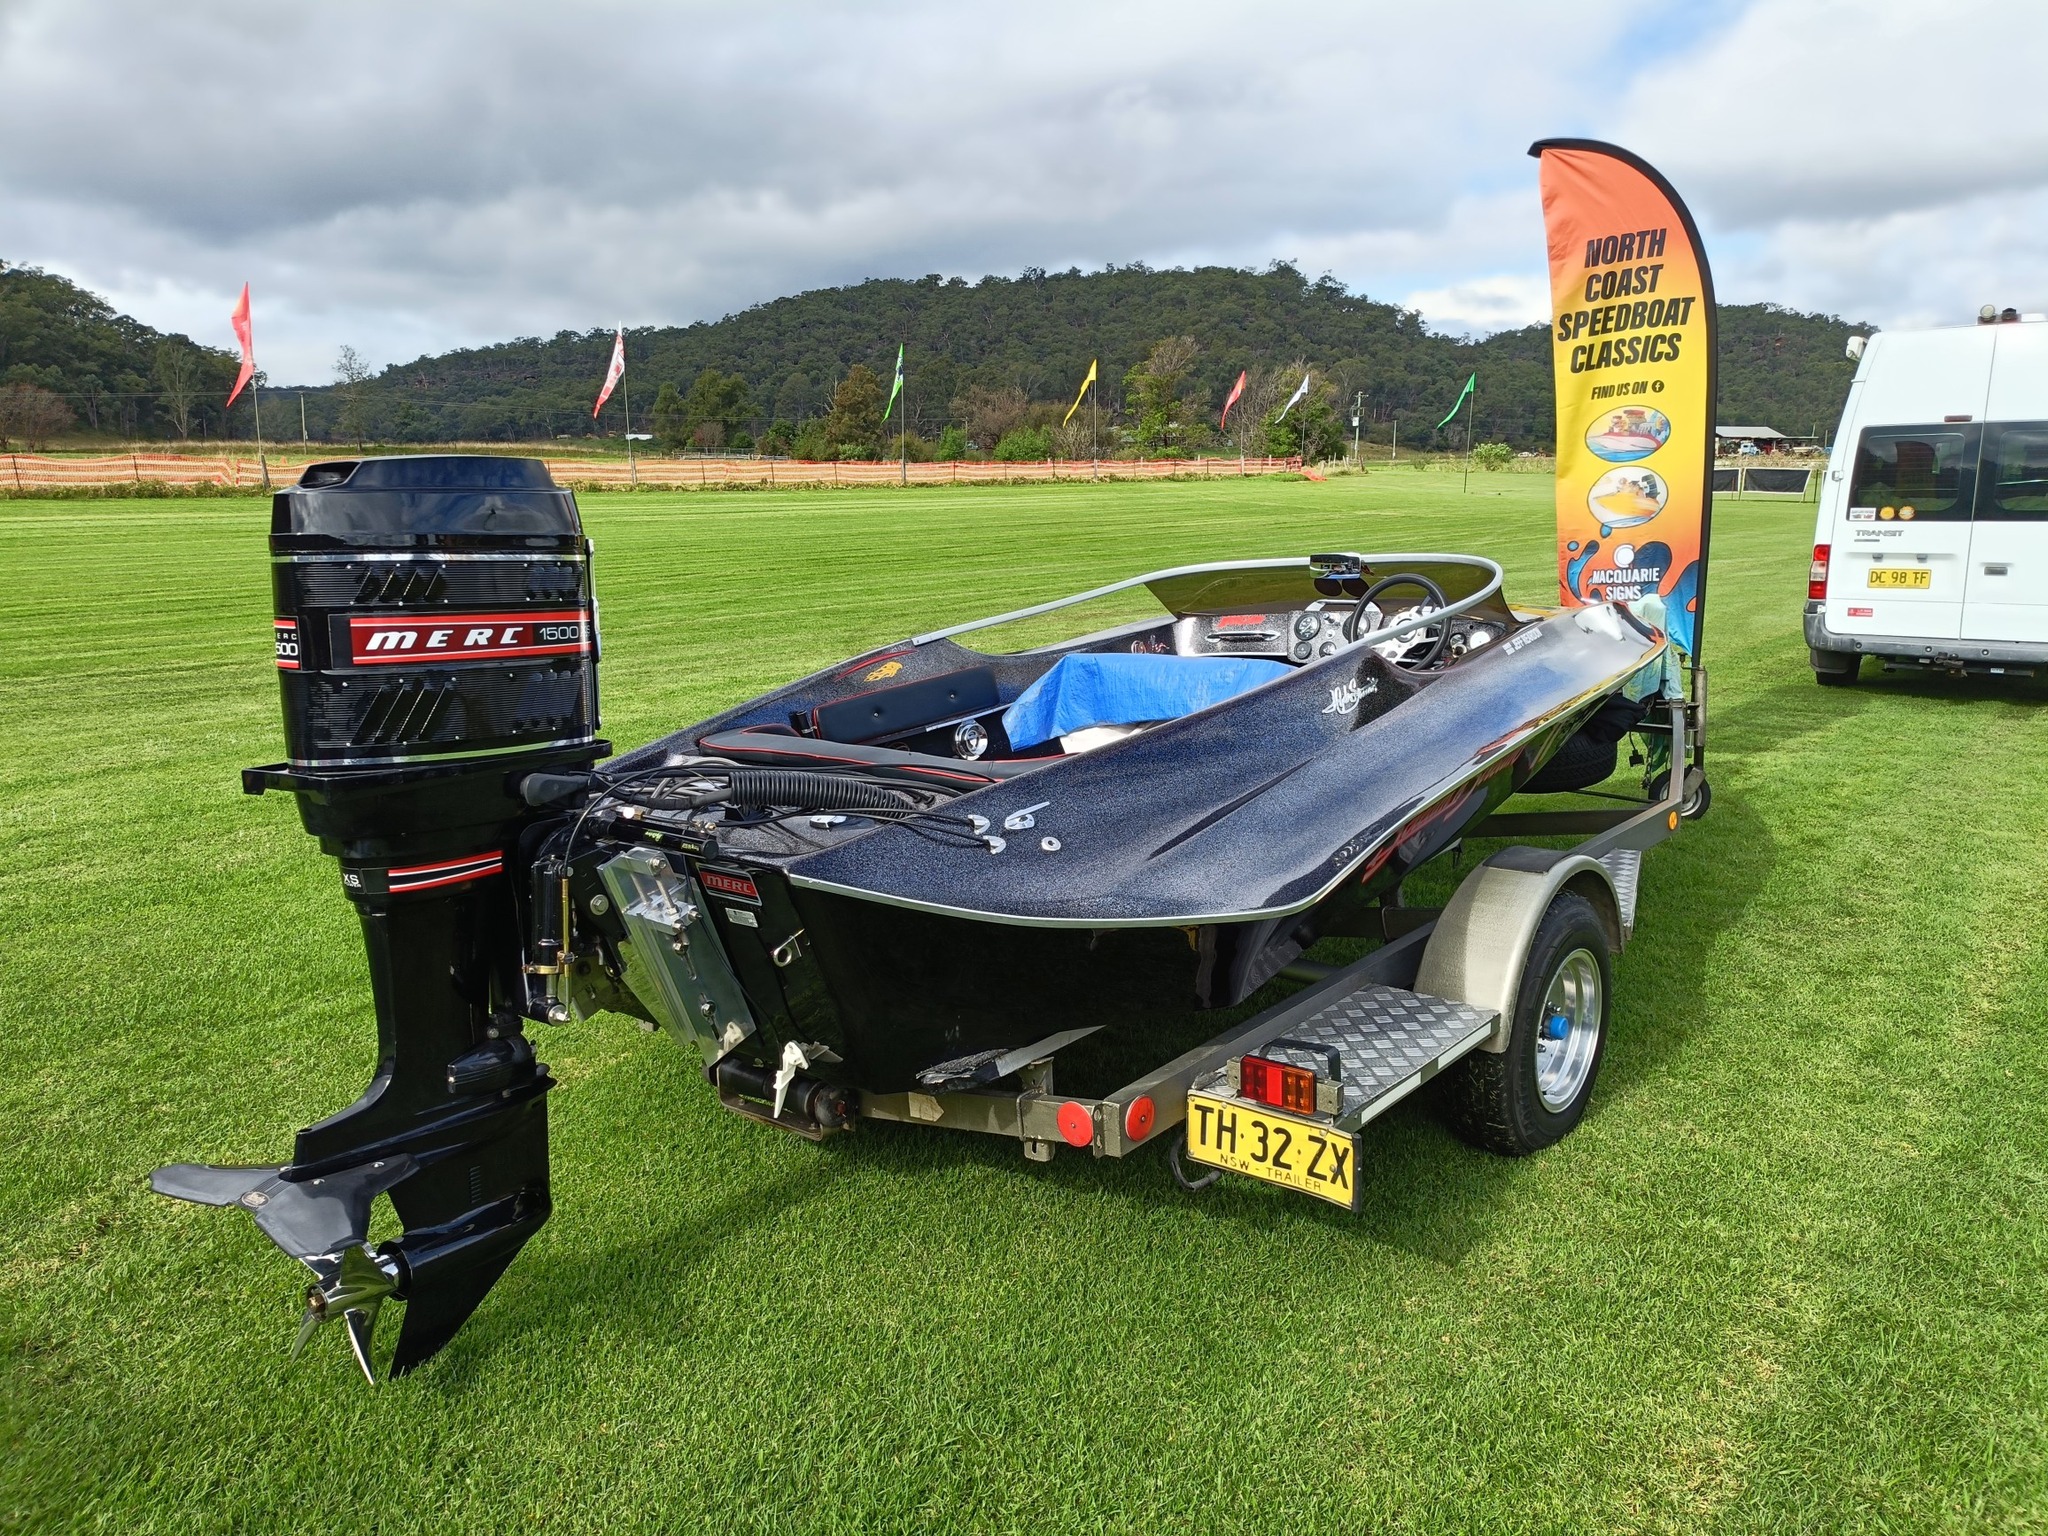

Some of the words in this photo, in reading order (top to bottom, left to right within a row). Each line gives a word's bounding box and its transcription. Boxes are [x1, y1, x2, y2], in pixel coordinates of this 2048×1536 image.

[1584, 228, 1667, 268] NORTH
[1585, 264, 1664, 302] COAST
[1557, 297, 1695, 342] SPEEDBOAT
[1570, 333, 1682, 374] CLASSICS
[1591, 385, 1615, 400] FIND
[1616, 383, 1631, 397] US
[1632, 381, 1649, 395] ON
[1855, 529, 1904, 537] TRANSIT
[1592, 567, 1660, 584] MACQUARIE
[1870, 571, 1887, 584] DC
[1891, 571, 1907, 584] 98
[1912, 571, 1929, 585] TF
[1605, 585, 1642, 601] SIGNS
[276, 632, 297, 640] ERC
[365, 627, 524, 650] MERC
[539, 626, 578, 640] 1500
[275, 642, 298, 656] 500
[343, 873, 359, 885] XS
[706, 875, 751, 893] MERC
[1220, 1153, 1250, 1172] NSW
[1266, 1166, 1321, 1192] TRAILER
